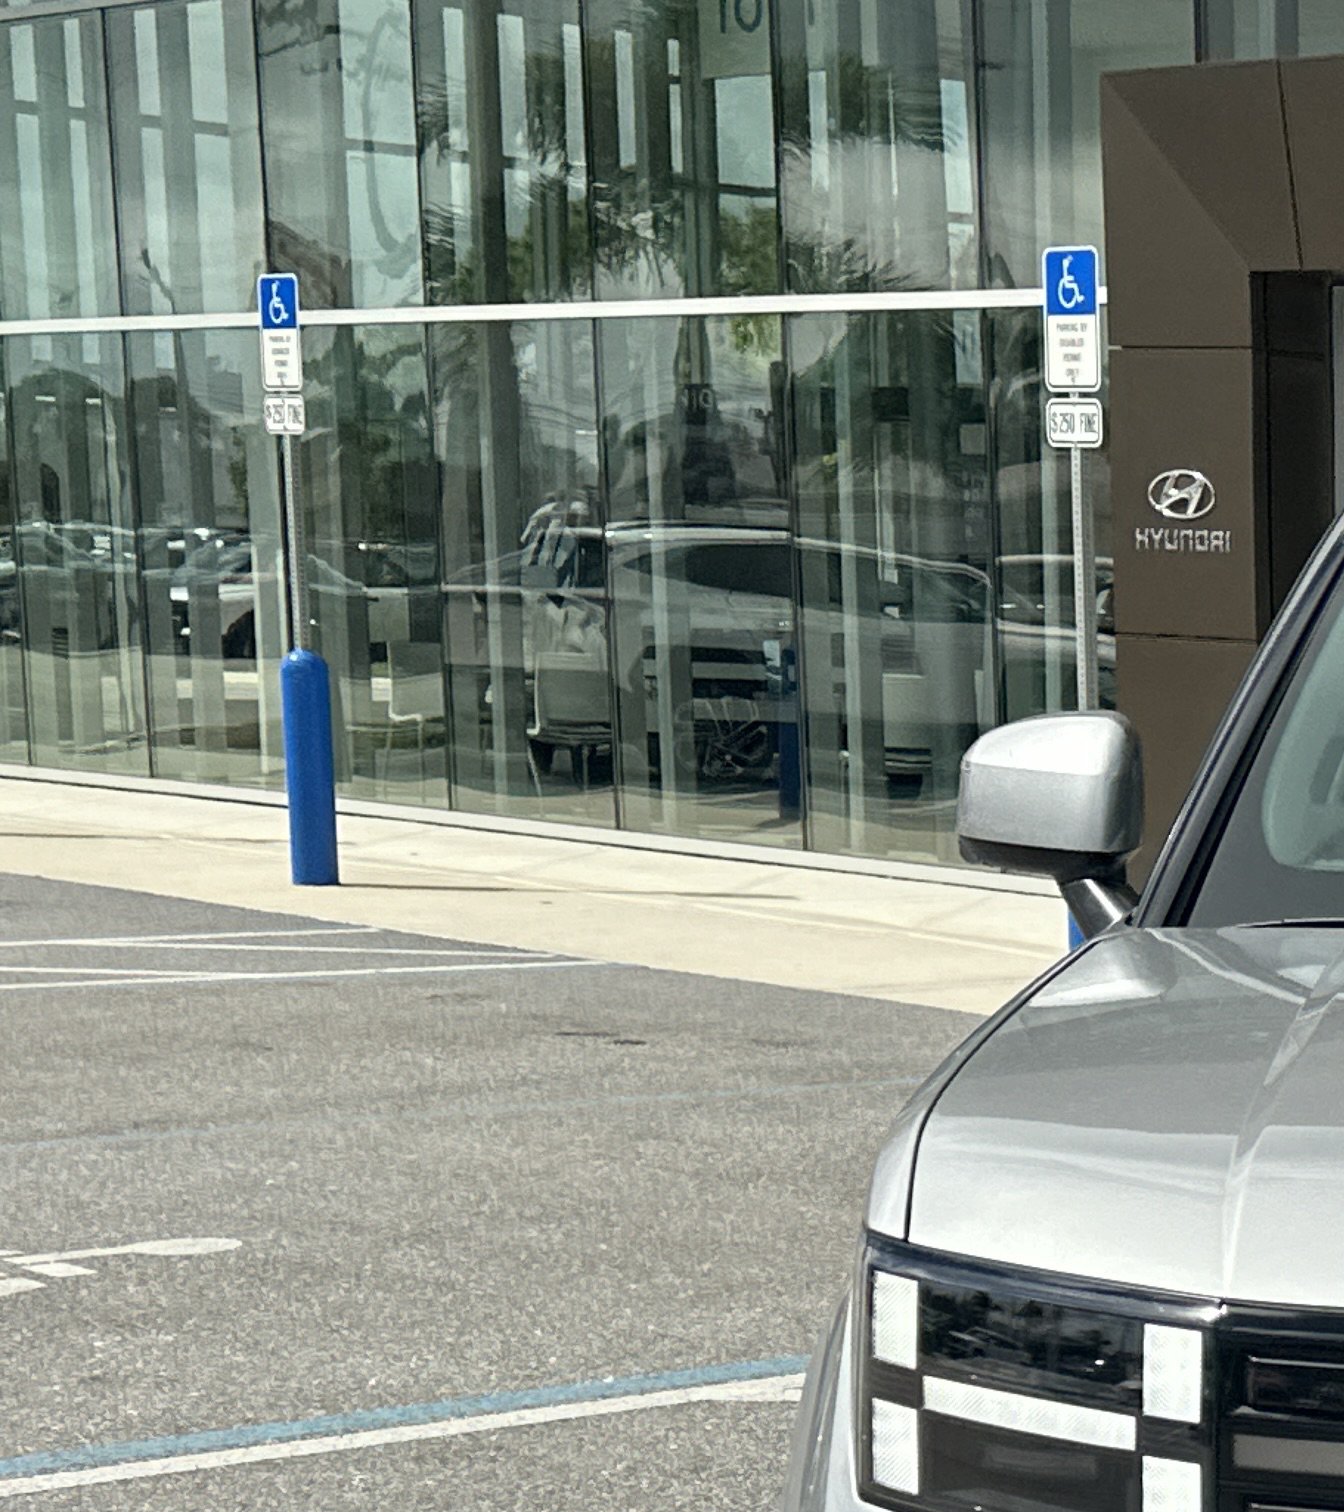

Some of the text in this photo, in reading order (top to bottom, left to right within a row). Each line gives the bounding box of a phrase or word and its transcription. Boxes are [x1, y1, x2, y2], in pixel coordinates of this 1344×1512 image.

[1051, 411, 1098, 434] $250 FINE
[1135, 527, 1231, 553] HYUNDAI
